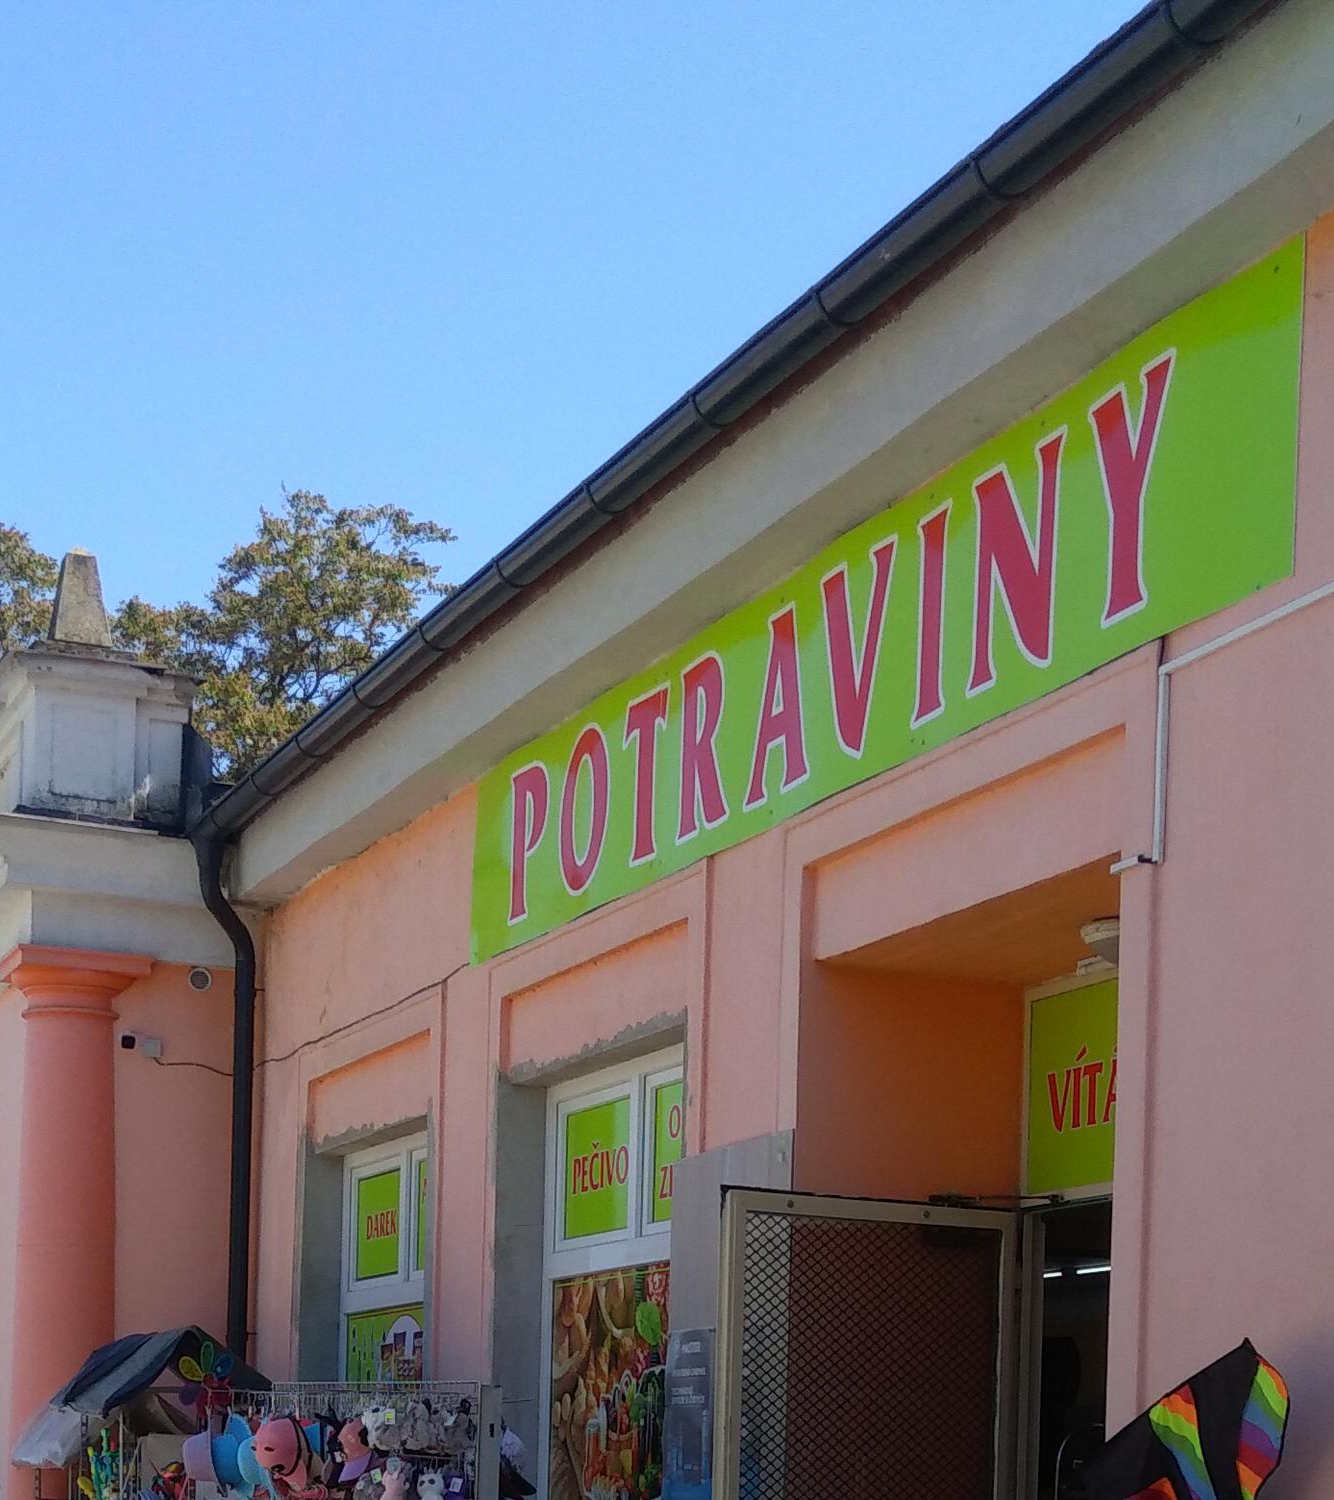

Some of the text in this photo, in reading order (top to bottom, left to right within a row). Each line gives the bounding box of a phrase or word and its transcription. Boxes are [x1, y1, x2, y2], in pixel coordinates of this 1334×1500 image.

[507, 348, 1176, 926] POTRAVINY
[572, 1142, 629, 1195] PEČIVO
[366, 1209, 397, 1240] DAREK
